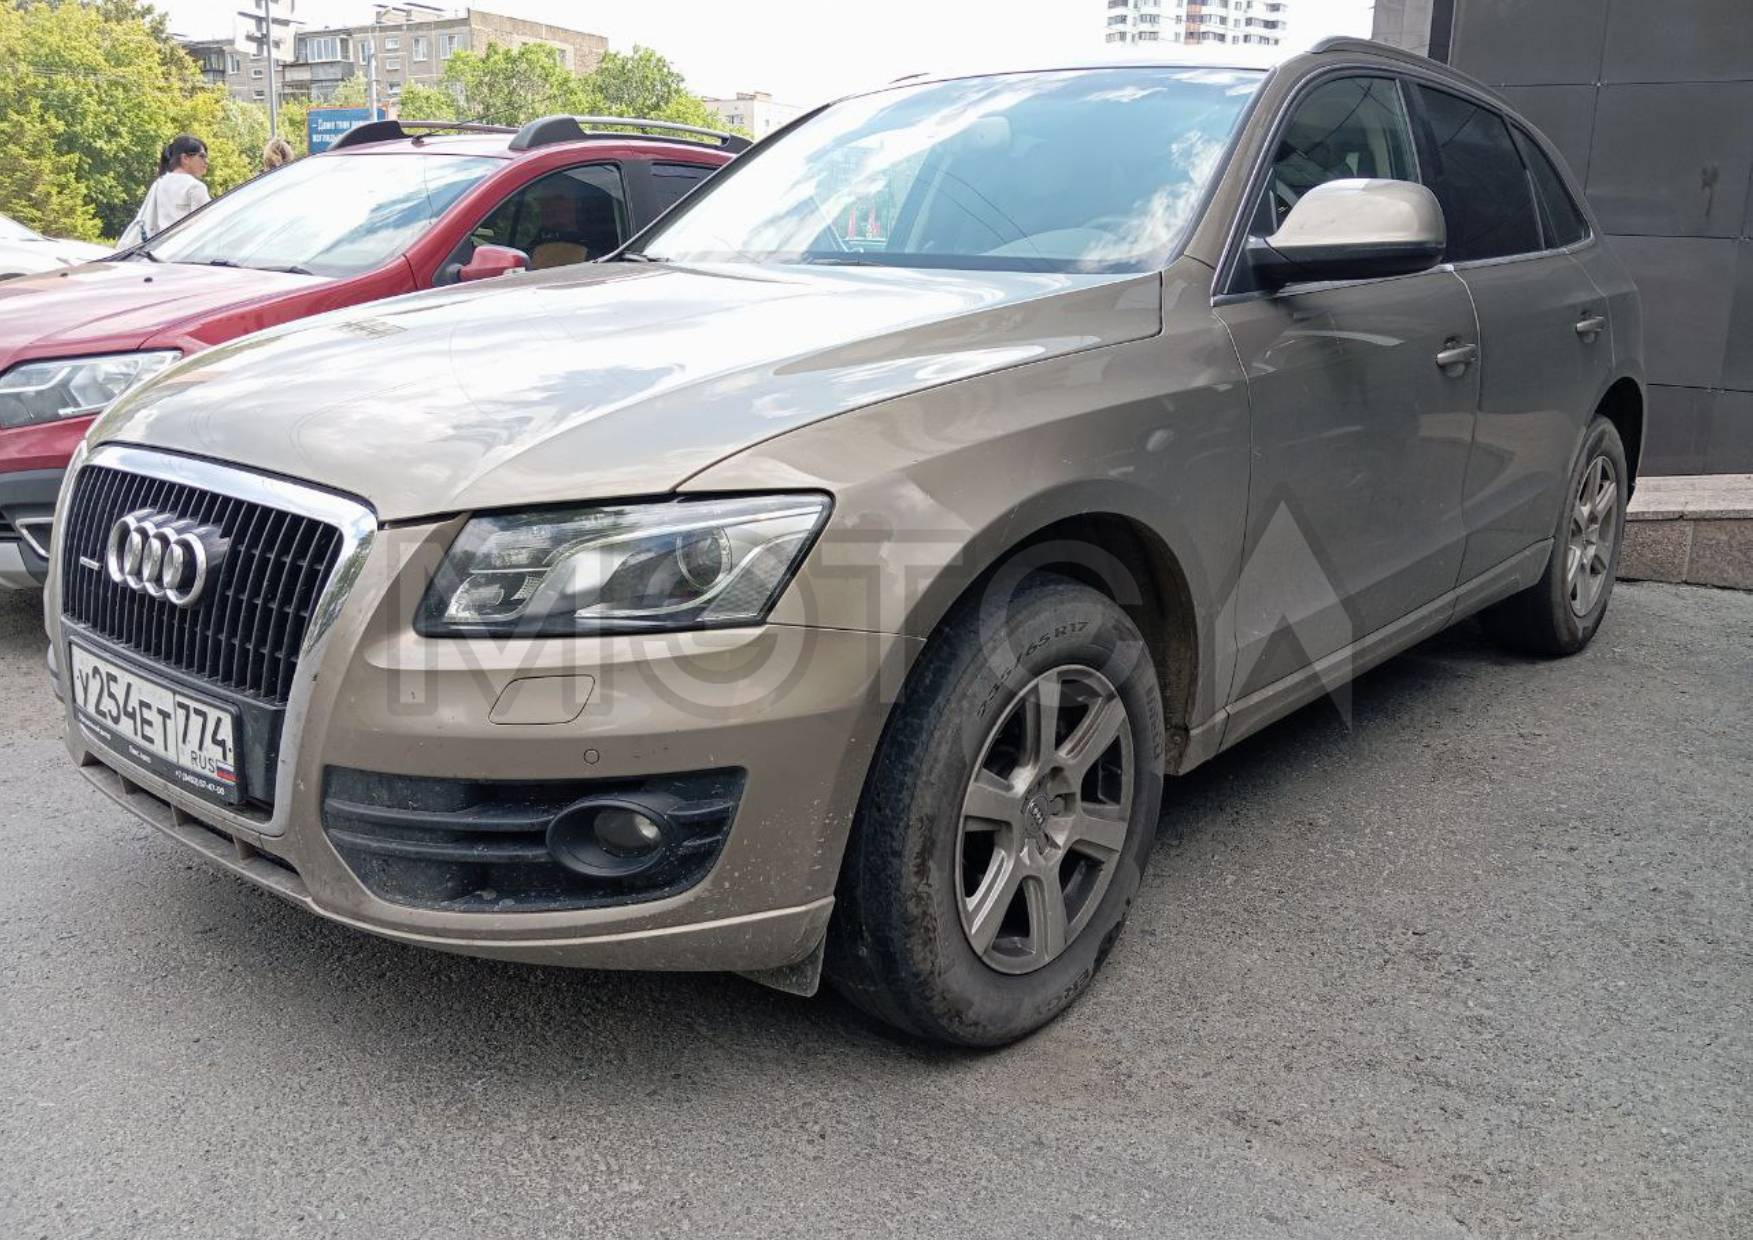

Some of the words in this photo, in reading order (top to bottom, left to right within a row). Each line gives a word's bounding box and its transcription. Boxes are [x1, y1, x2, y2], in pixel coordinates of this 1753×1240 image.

[1054, 621, 1089, 638] R17
[177, 701, 228, 761] 774
[190, 750, 216, 773] RUS
